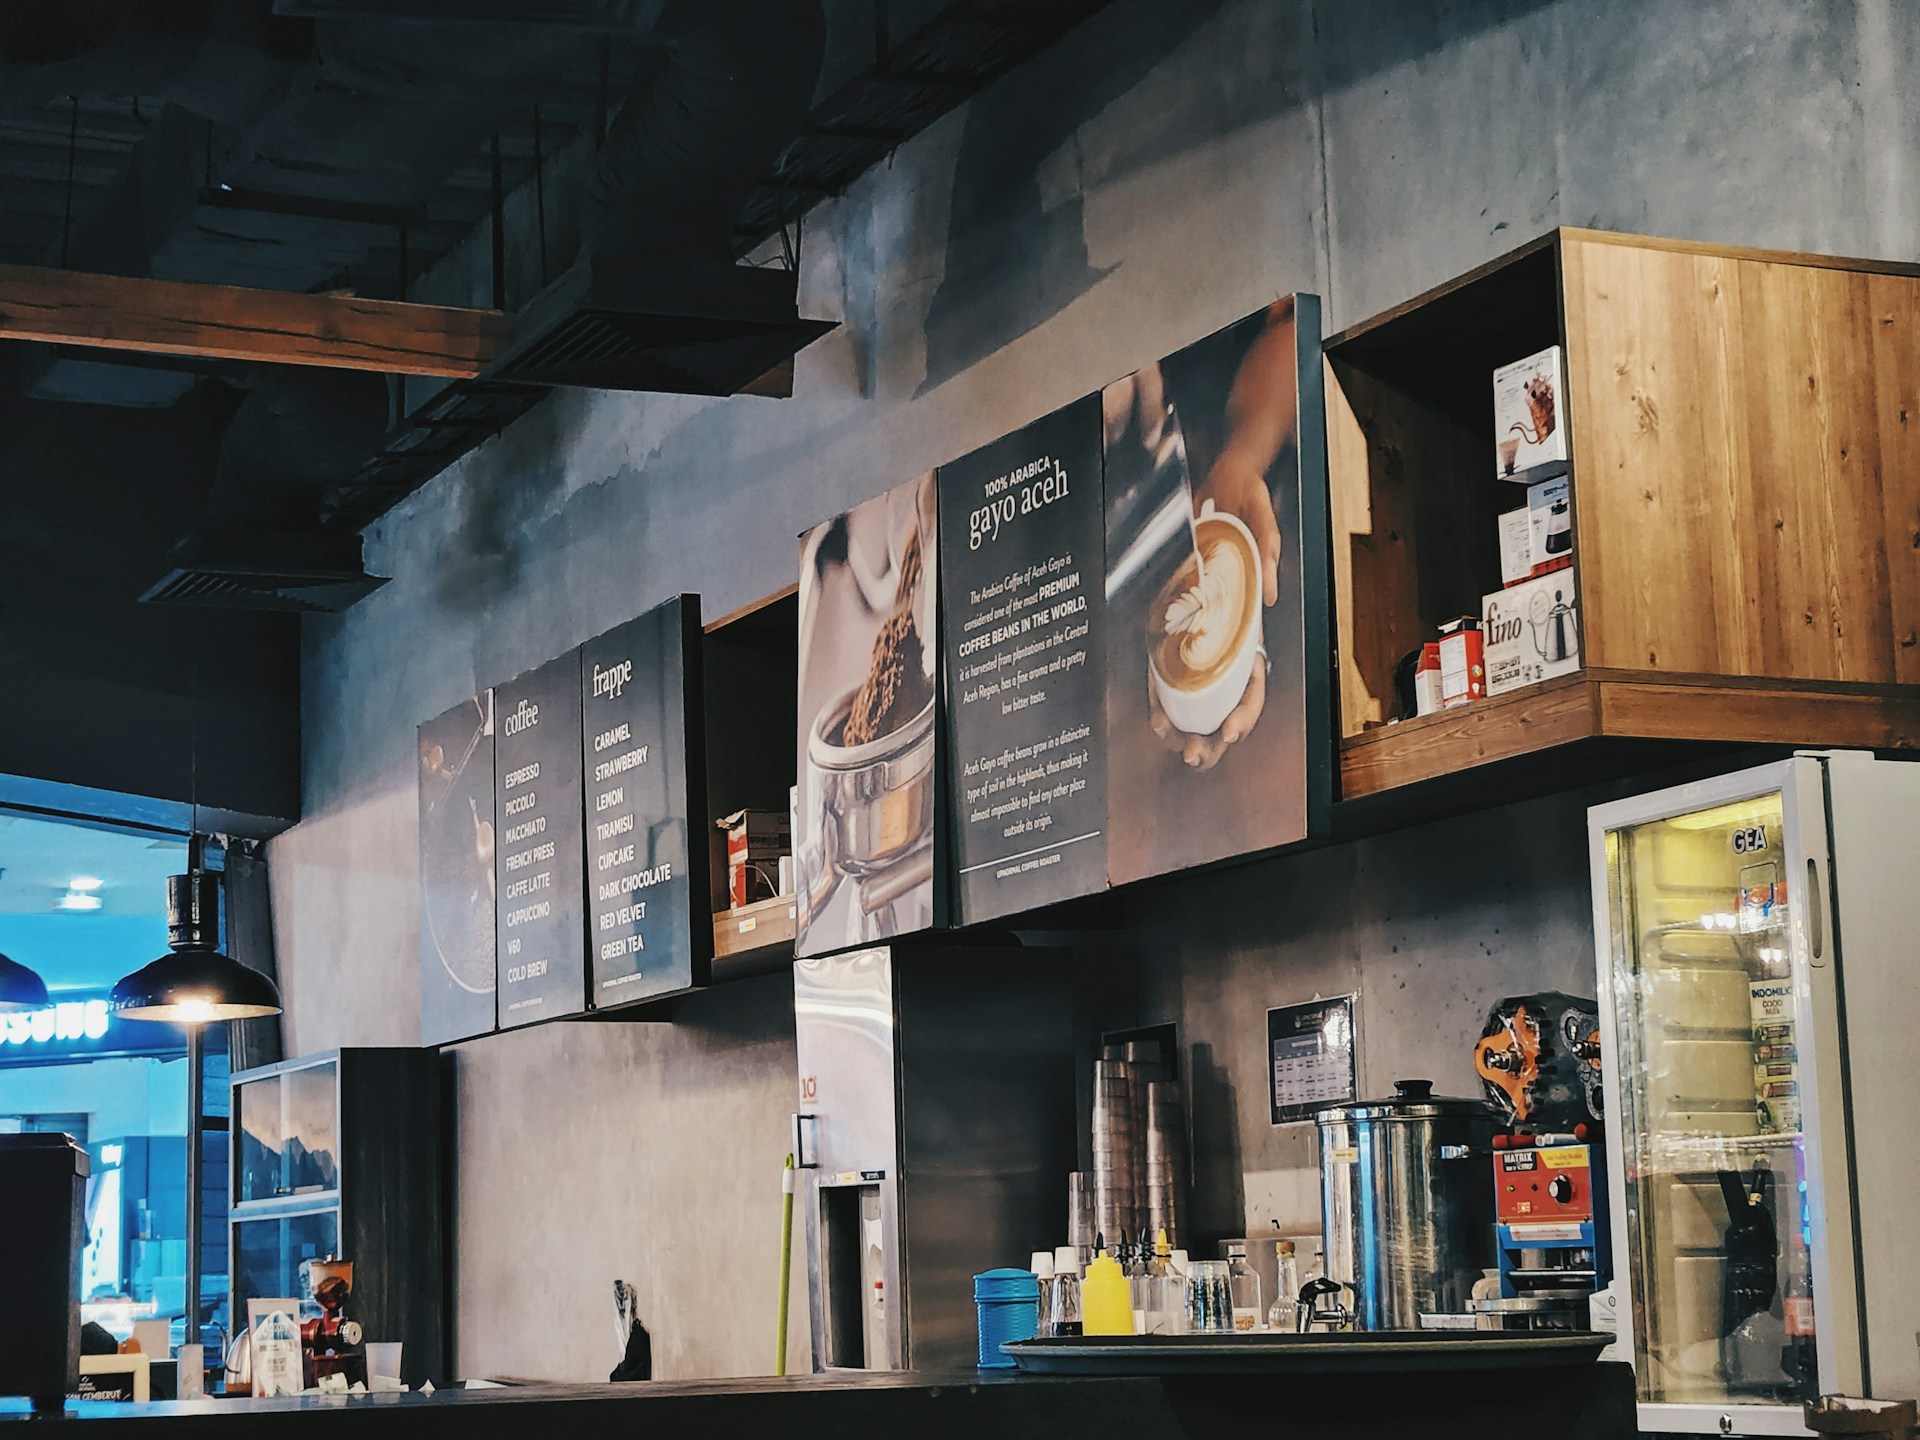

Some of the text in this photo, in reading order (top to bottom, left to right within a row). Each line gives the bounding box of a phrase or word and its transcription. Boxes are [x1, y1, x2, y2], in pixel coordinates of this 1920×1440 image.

[985, 456, 1051, 498] 100% ARABICA
[970, 459, 1069, 550] gayo aceh
[970, 590, 980, 605] The
[1004, 572, 1023, 592] Coffee
[1024, 567, 1032, 585] of
[1031, 563, 1047, 579] Aceh
[1048, 557, 1065, 574] Gayo
[1065, 552, 1071, 568] is
[964, 572, 1080, 632] considered one of the most PREMIUM
[959, 596, 1088, 657] COFFEE BEANS IN THE WORLD,
[1487, 602, 1521, 647] fino
[965, 664, 970, 679] is
[971, 655, 997, 677] harvested
[998, 649, 1012, 671] from
[1012, 640, 1045, 665] plantations
[1046, 635, 1052, 648] in
[1053, 631, 1063, 645] the
[1065, 619, 1089, 640] Central
[593, 659, 632, 699] frappe
[963, 689, 978, 704] Aceh
[1001, 677, 1011, 691] has
[1012, 677, 1017, 686] a
[1017, 670, 1028, 689] fine
[1029, 665, 1048, 681] aroma
[1049, 656, 1060, 673] and
[1062, 658, 1066, 668] a
[1066, 650, 1086, 671] pretty
[505, 699, 539, 737] coffee
[1002, 702, 1012, 715] low
[1013, 695, 1029, 711] bitter
[595, 723, 631, 752] CARAMEL
[964, 724, 1090, 777] Aceh Gayo coffee beans grow in a distinctive
[506, 763, 540, 789] ESPRESSO
[596, 746, 648, 782] STRAWBERRY
[967, 786, 980, 803] type
[981, 779, 989, 799] of
[989, 778, 999, 793] soil
[999, 777, 1005, 789] in
[1006, 773, 1016, 787] the
[1047, 761, 1060, 775] thus
[1061, 753, 1082, 769] making
[1083, 749, 1088, 762] it
[506, 792, 535, 817] PICCOLO
[597, 787, 623, 812] LEMON
[971, 777, 1086, 822] almost impossible to find any other place
[506, 817, 546, 844] MACCHIATO
[597, 814, 634, 841] TIRAMISU
[1004, 820, 1025, 837] outside
[1025, 818, 1033, 831] its
[1733, 826, 1767, 854] GEA
[506, 842, 555, 872] FRENCH PRESS
[599, 845, 634, 871] CUPCAKE
[1021, 859, 1039, 871] COFFEE
[1040, 854, 1061, 866] ROASTER
[507, 872, 550, 899] CAFFE LATTE
[599, 863, 671, 901] DARK CHOCOLATE
[507, 901, 550, 927] CAPPUCCINO
[600, 902, 646, 930] RED VELVET
[508, 938, 521, 955] V60
[601, 934, 644, 961] GREEN TEA
[508, 959, 547, 983] COLD BREW
[1504, 1152, 1532, 1162] MATRIX
